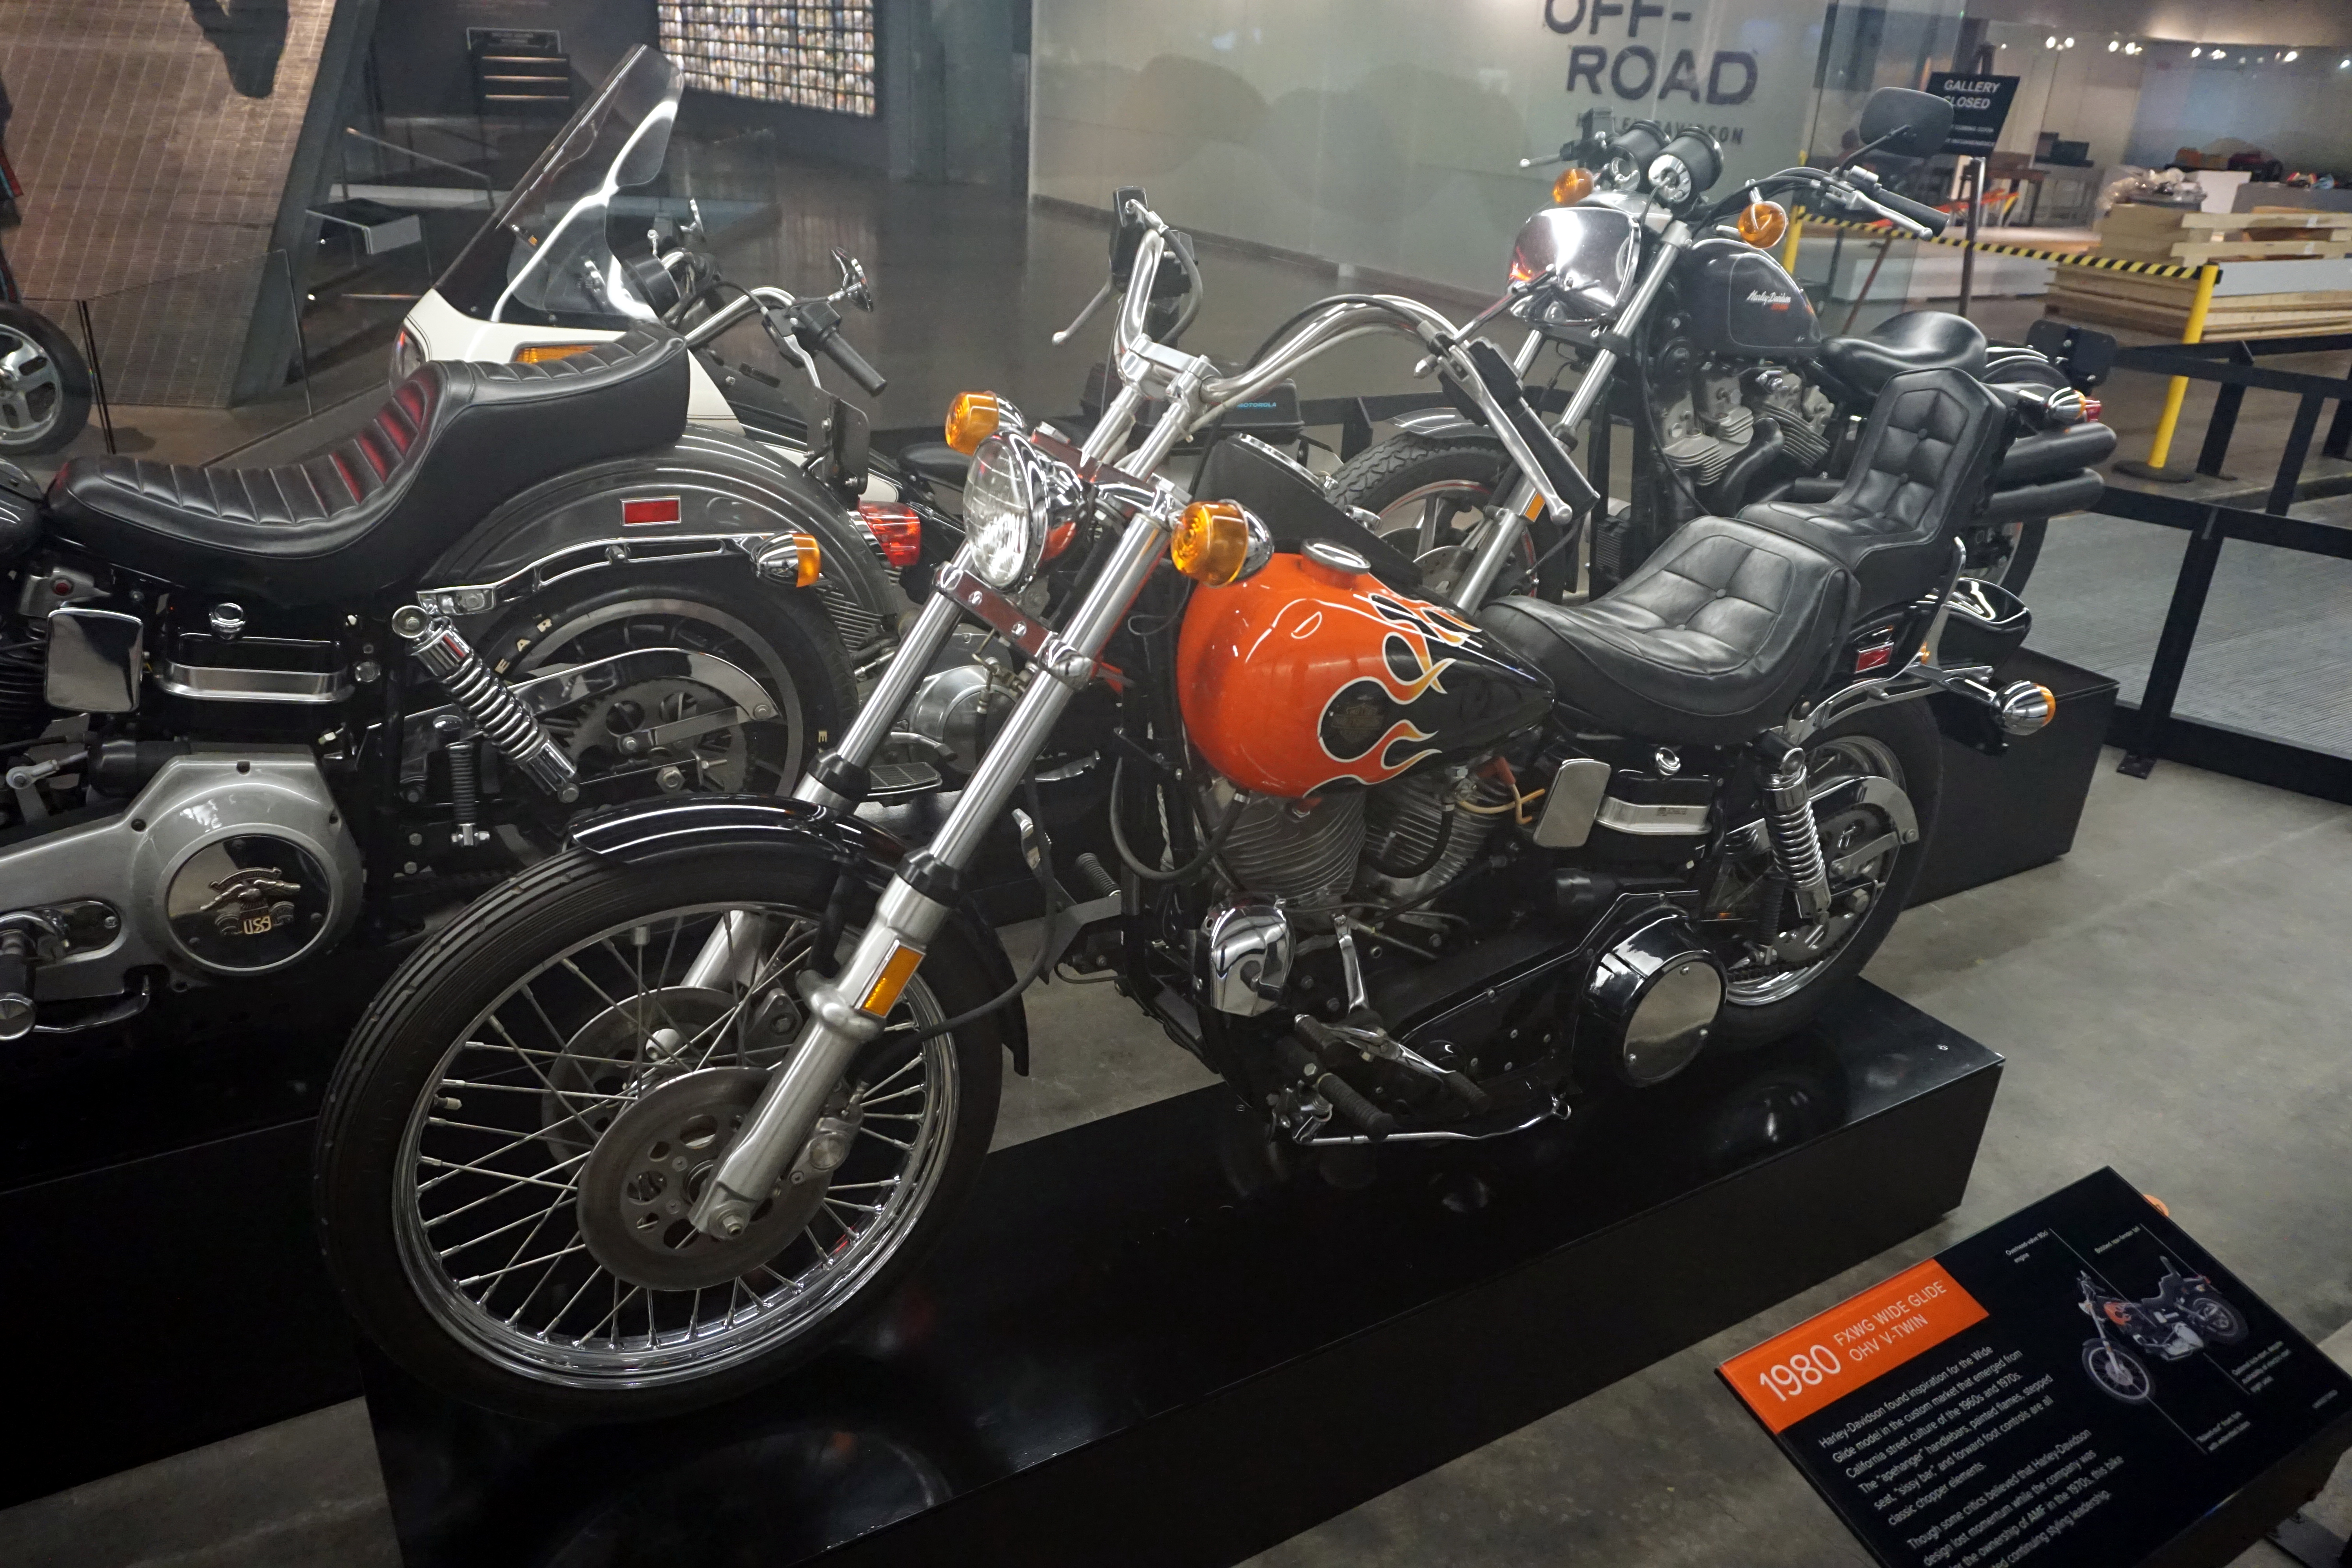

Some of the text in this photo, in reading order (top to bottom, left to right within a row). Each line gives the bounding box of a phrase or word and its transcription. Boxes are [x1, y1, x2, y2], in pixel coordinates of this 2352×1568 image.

[1545, 0, 1692, 37] OFF-
[1566, 45, 1758, 105] ROAD
[1944, 80, 2000, 93] GALLERY
[1746, 289, 1791, 306] Harley-Davidson
[243, 915, 272, 935] USA
[1833, 1280, 1947, 1347] FXWG WIDE GLIDE
[1849, 1314, 1928, 1361] OHV V-TWIN
[1759, 1344, 1841, 1402] 1980
[1818, 1347, 1993, 1448] Harley-Davidson found inspiration for the Wide
[1832, 1350, 2023, 1463] Glide model in the custom market that emerged from
[1846, 1452, 1887, 1478] California
[1886, 1436, 1911, 1455] street
[1910, 1421, 1938, 1441] culture
[1937, 1413, 1947, 1425] of
[1945, 1408, 1961, 1419] the
[1958, 1394, 1984, 1410] 1960s
[1983, 1383, 2000, 1398] and
[1858, 1480, 1878, 1493] The
[1969, 1406, 1999, 1430] painted
[2023, 1374, 2054, 1396] stepped
[1937, 1455, 1955, 1471] and
[1952, 1437, 1985, 1460] forward
[1982, 1428, 2002, 1442] foot
[2000, 1411, 2031, 1432] controls
[2029, 1403, 2044, 1414] are
[2042, 1395, 2054, 1406] all
[1888, 1504, 1917, 1526] classic
[1915, 1484, 1949, 1508] chopper
